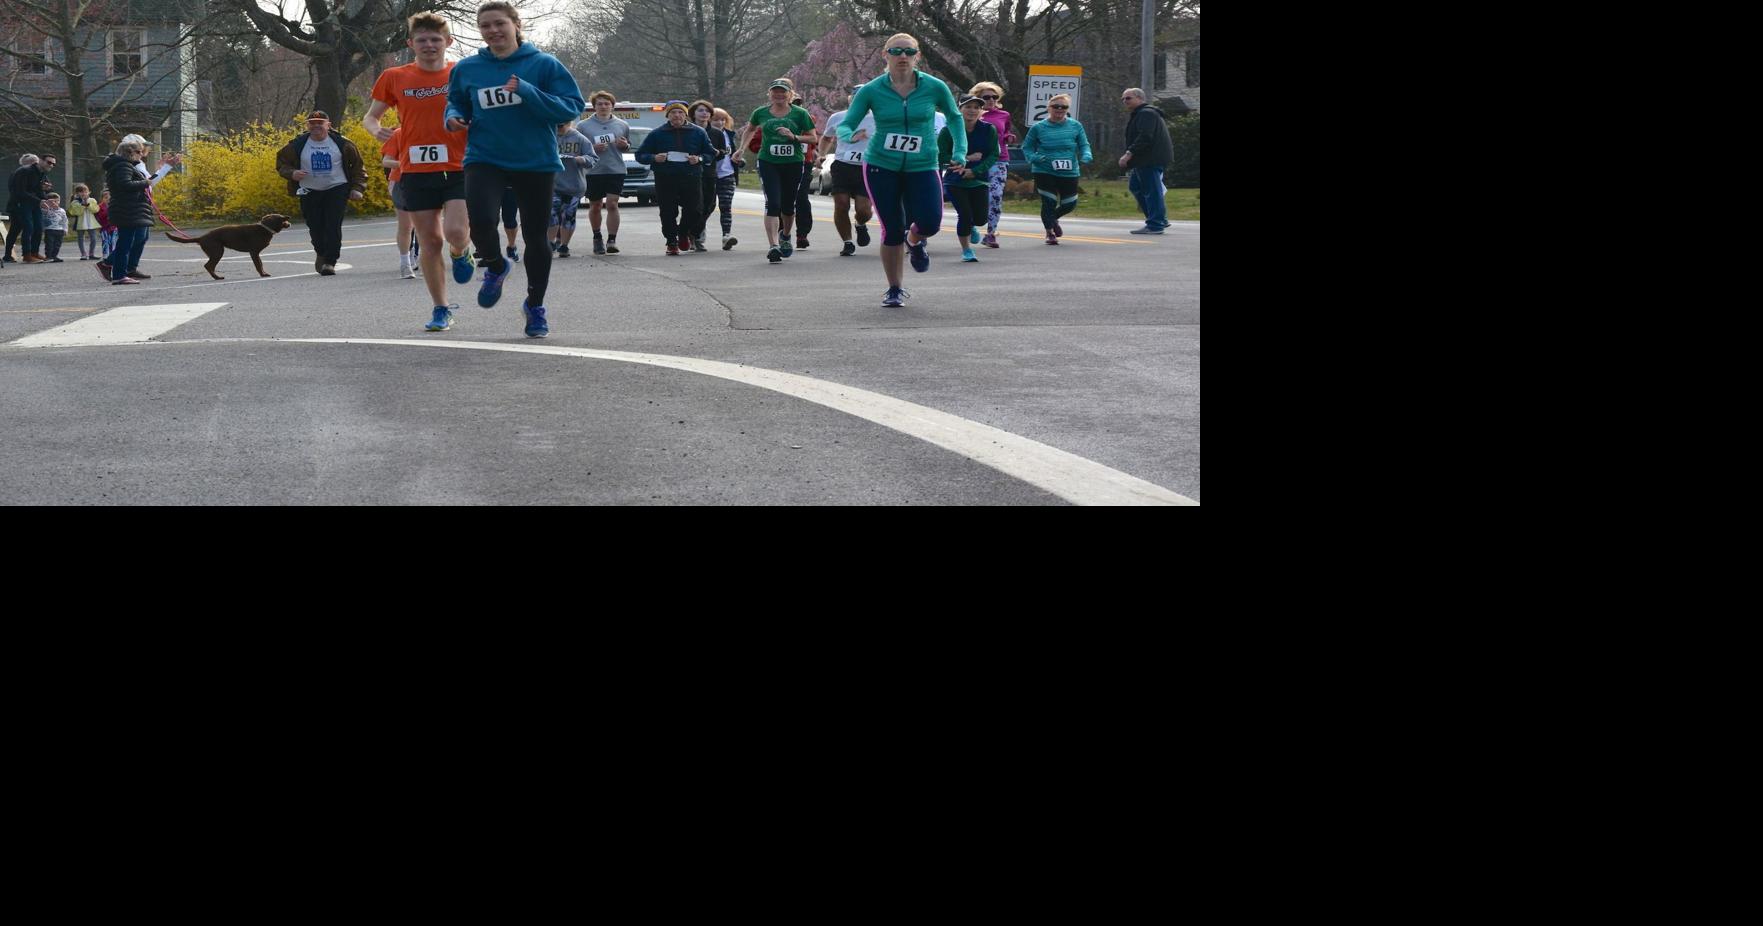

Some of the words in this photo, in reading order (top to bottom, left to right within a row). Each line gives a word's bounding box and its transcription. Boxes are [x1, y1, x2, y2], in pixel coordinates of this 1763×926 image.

[1033, 80, 1076, 90] SPEED
[404, 89, 414, 97] THE
[484, 88, 515, 107] 167
[600, 134, 610, 144] 80
[890, 135, 918, 151] 175
[419, 146, 438, 162] 76
[774, 145, 792, 155] 168
[850, 151, 862, 161] 74
[1055, 160, 1070, 169] 171
